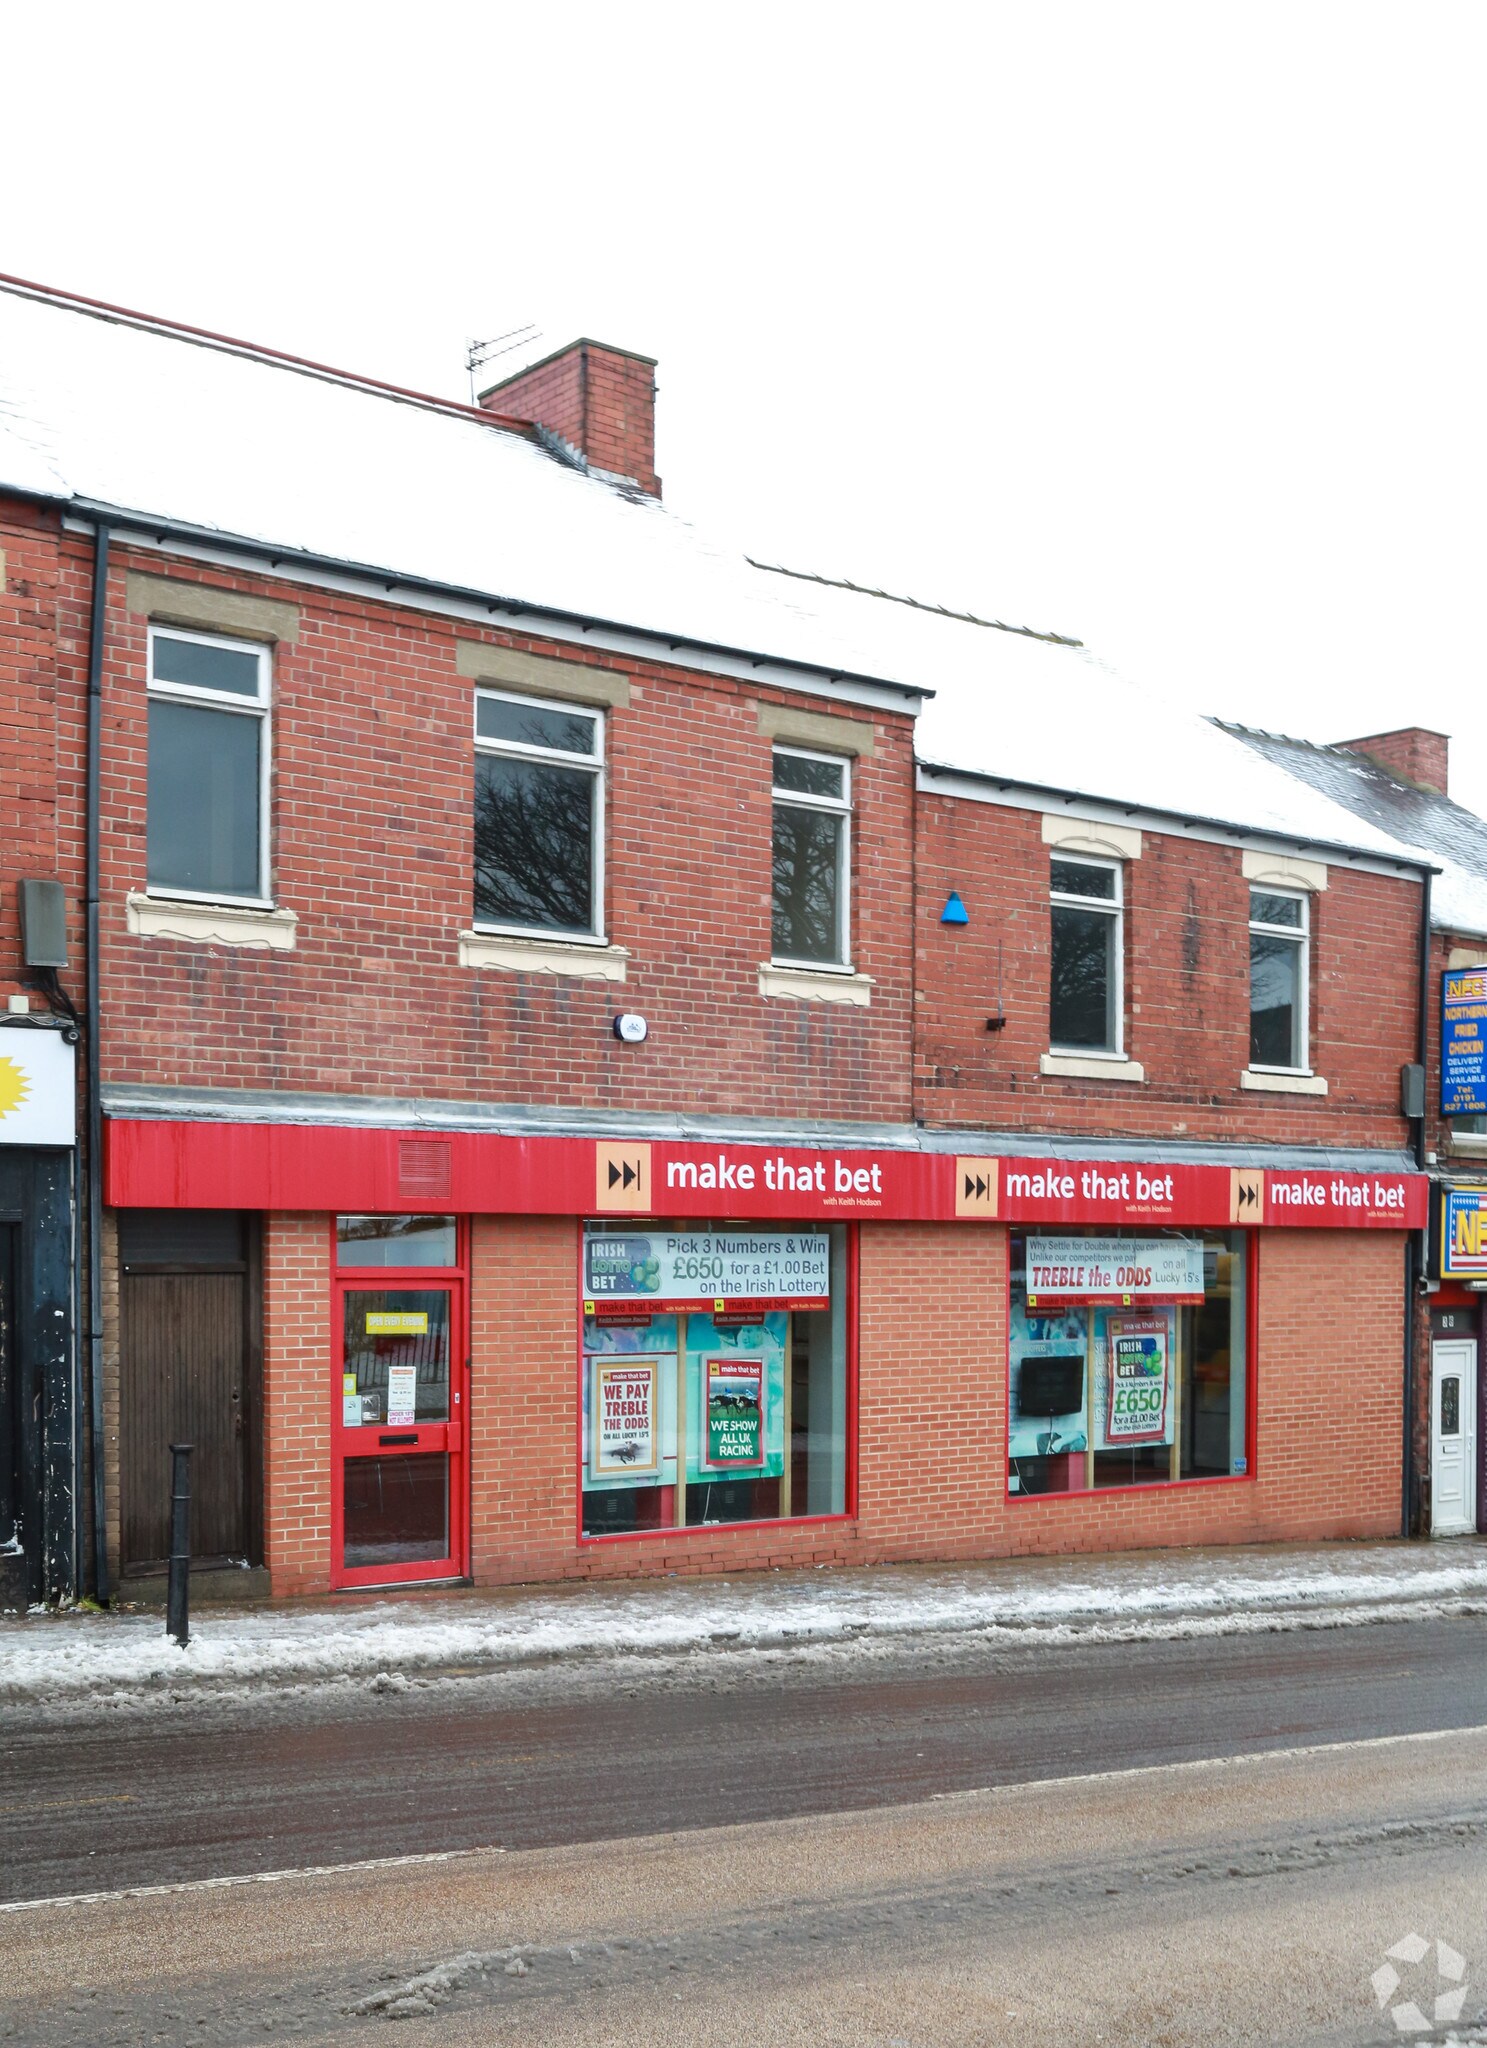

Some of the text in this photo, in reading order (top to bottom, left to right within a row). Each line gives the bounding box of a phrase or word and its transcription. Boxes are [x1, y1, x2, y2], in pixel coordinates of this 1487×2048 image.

[1448, 978, 1484, 998] NFC
[1445, 1004, 1487, 1020] NORTHERN
[1454, 1023, 1478, 1037] FRIED
[1448, 1040, 1484, 1055] CHICKEN
[1447, 1057, 1483, 1066] DELIVERY
[1449, 1066, 1482, 1075] SERVICE
[1445, 1075, 1486, 1084] AVAILABLE
[1453, 1094, 1476, 1102] 0191
[1444, 1103, 1461, 1111] 527
[667, 1155, 882, 1193] make that bet
[1006, 1168, 1173, 1201] make that bet
[1271, 1177, 1405, 1208] make that bet
[822, 1197, 882, 1207] with Keith Hodson
[591, 1243, 625, 1257] IRISH
[667, 1239, 826, 1253] Pick 3 Numbers & Win
[1030, 1240, 1046, 1251] Why
[1049, 1240, 1069, 1250] Settle
[1072, 1241, 1083, 1250] for
[1084, 1241, 1111, 1250] Double
[1111, 1242, 1130, 1250] when
[1132, 1244, 1145, 1253] you
[1146, 1243, 1159, 1251] can
[1029, 1253, 1053, 1262] Unlike
[1069, 1254, 1111, 1263] competitors
[1162, 1259, 1185, 1269] on all
[591, 1260, 631, 1273] LOTTO
[673, 1257, 723, 1279] £650
[730, 1260, 825, 1274] for a £1.00 Bet
[592, 1275, 616, 1289] BET
[1032, 1264, 1152, 1287] TREBLE the ODDS
[1155, 1272, 1180, 1285] Lucky
[1183, 1272, 1200, 1283] 15's
[700, 1278, 826, 1295] on the Irish Lottery
[600, 1301, 663, 1312] make that bet
[728, 1299, 788, 1309] make that bet
[1142, 1321, 1154, 1329] that
[1155, 1320, 1165, 1328] bet
[1119, 1341, 1142, 1353] IRISH
[1120, 1365, 1135, 1376] BET
[604, 1383, 649, 1400] WE PAY
[1114, 1387, 1161, 1413] £650
[605, 1400, 647, 1417] TREBLE
[604, 1417, 649, 1430] THE ODDS
[1114, 1415, 1123, 1424] for
[1130, 1413, 1148, 1423] £1.00
[1149, 1413, 1160, 1421] Bet
[711, 1420, 757, 1431] WE SHOW
[721, 1433, 751, 1443] ALL UK
[719, 1445, 753, 1456] RACING
